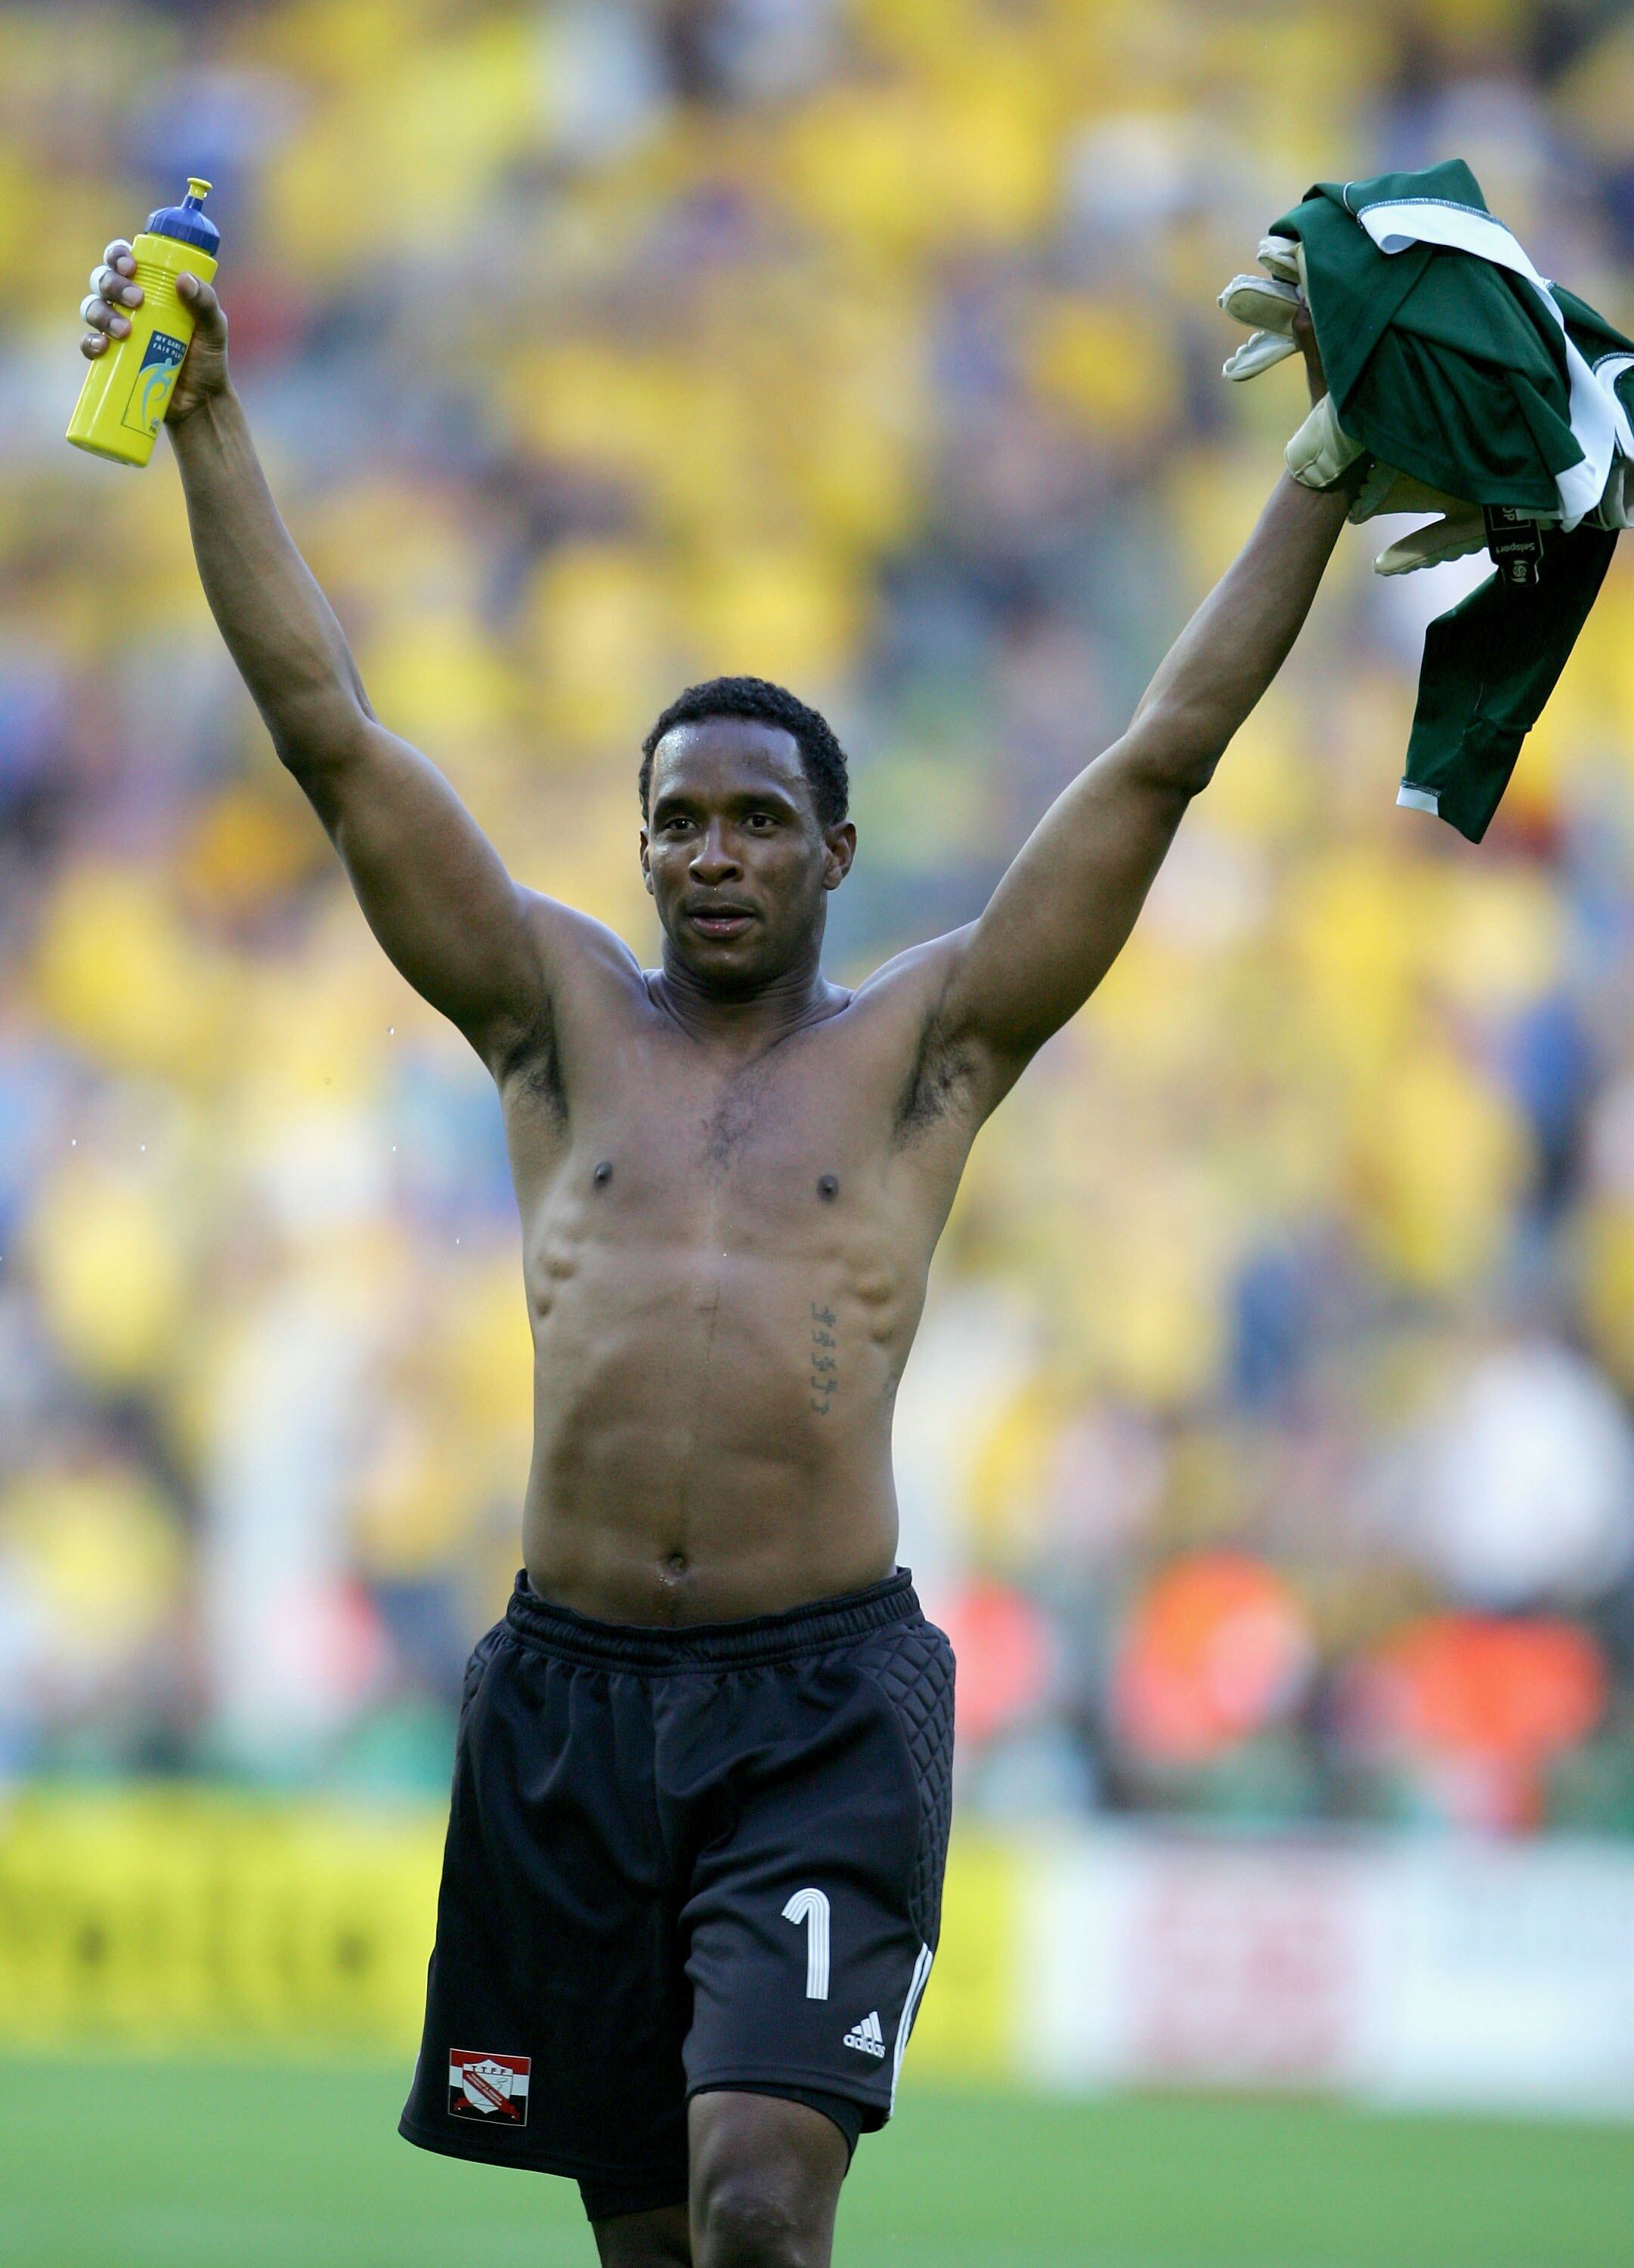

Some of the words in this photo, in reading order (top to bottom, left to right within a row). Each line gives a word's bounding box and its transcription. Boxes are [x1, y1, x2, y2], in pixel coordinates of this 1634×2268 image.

[153, 342, 170, 354] FAIR
[155, 335, 166, 343] MY
[781, 1887, 831, 2001] 1
[843, 2034, 886, 2059] adidas
